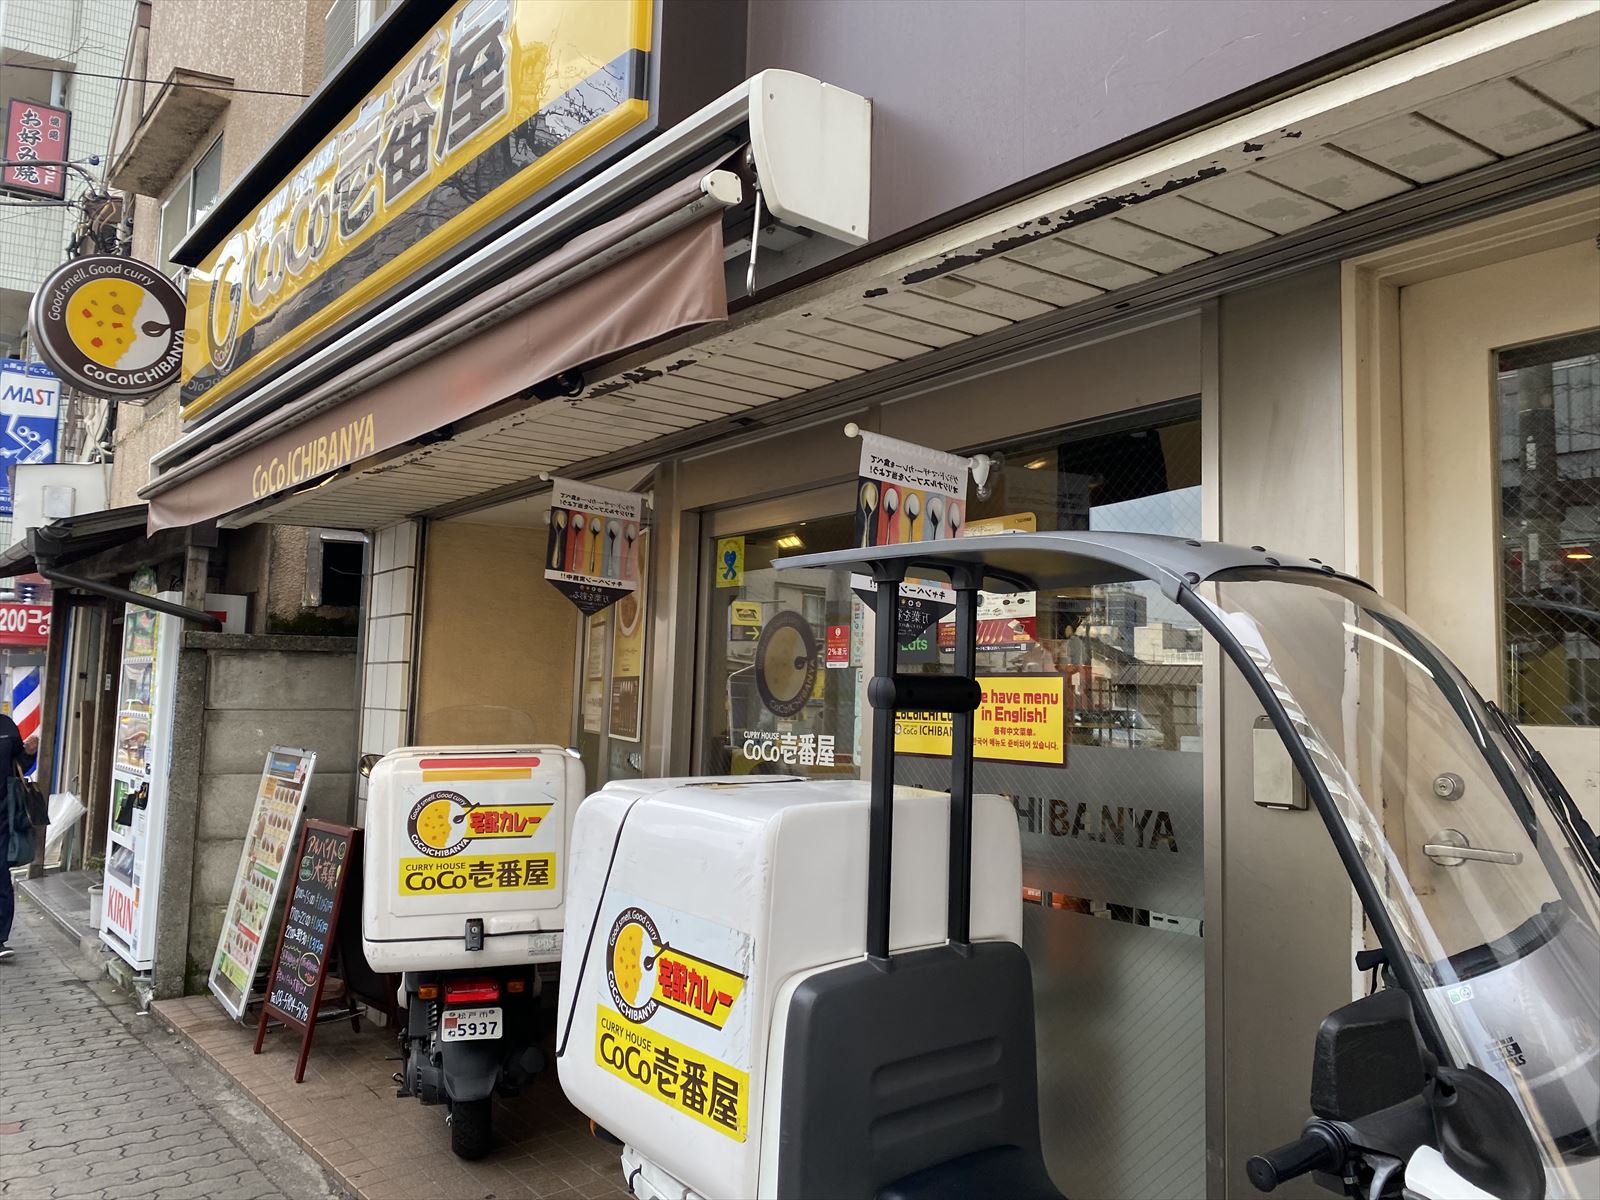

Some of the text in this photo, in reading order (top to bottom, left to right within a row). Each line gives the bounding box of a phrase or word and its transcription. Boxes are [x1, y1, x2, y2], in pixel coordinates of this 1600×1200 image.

[48, 264, 155, 321] Good smell. Good curry
[83, 329, 186, 386] CoCoICHIBANYA
[2, 385, 55, 406] MAST
[991, 689, 1021, 704] have
[1024, 692, 1058, 705] menu
[981, 706, 1047, 723] in English!
[761, 732, 780, 740] HOUSE
[410, 804, 421, 820] Good
[453, 795, 467, 806] curry
[470, 811, 542, 834] 宅配カレー
[411, 834, 469, 857] CoCoICHIBANYA
[405, 862, 466, 872] CURRY HOUSE
[108, 885, 133, 935] KIRIN
[610, 923, 619, 946] Good
[632, 910, 647, 924] Good
[645, 920, 658, 941] curry
[608, 971, 657, 1021] CoCoICHIBANYA
[658, 958, 734, 1016] 宅配カレー
[458, 1022, 498, 1036] 5937
[601, 1018, 652, 1052] CURRY HOUSE
